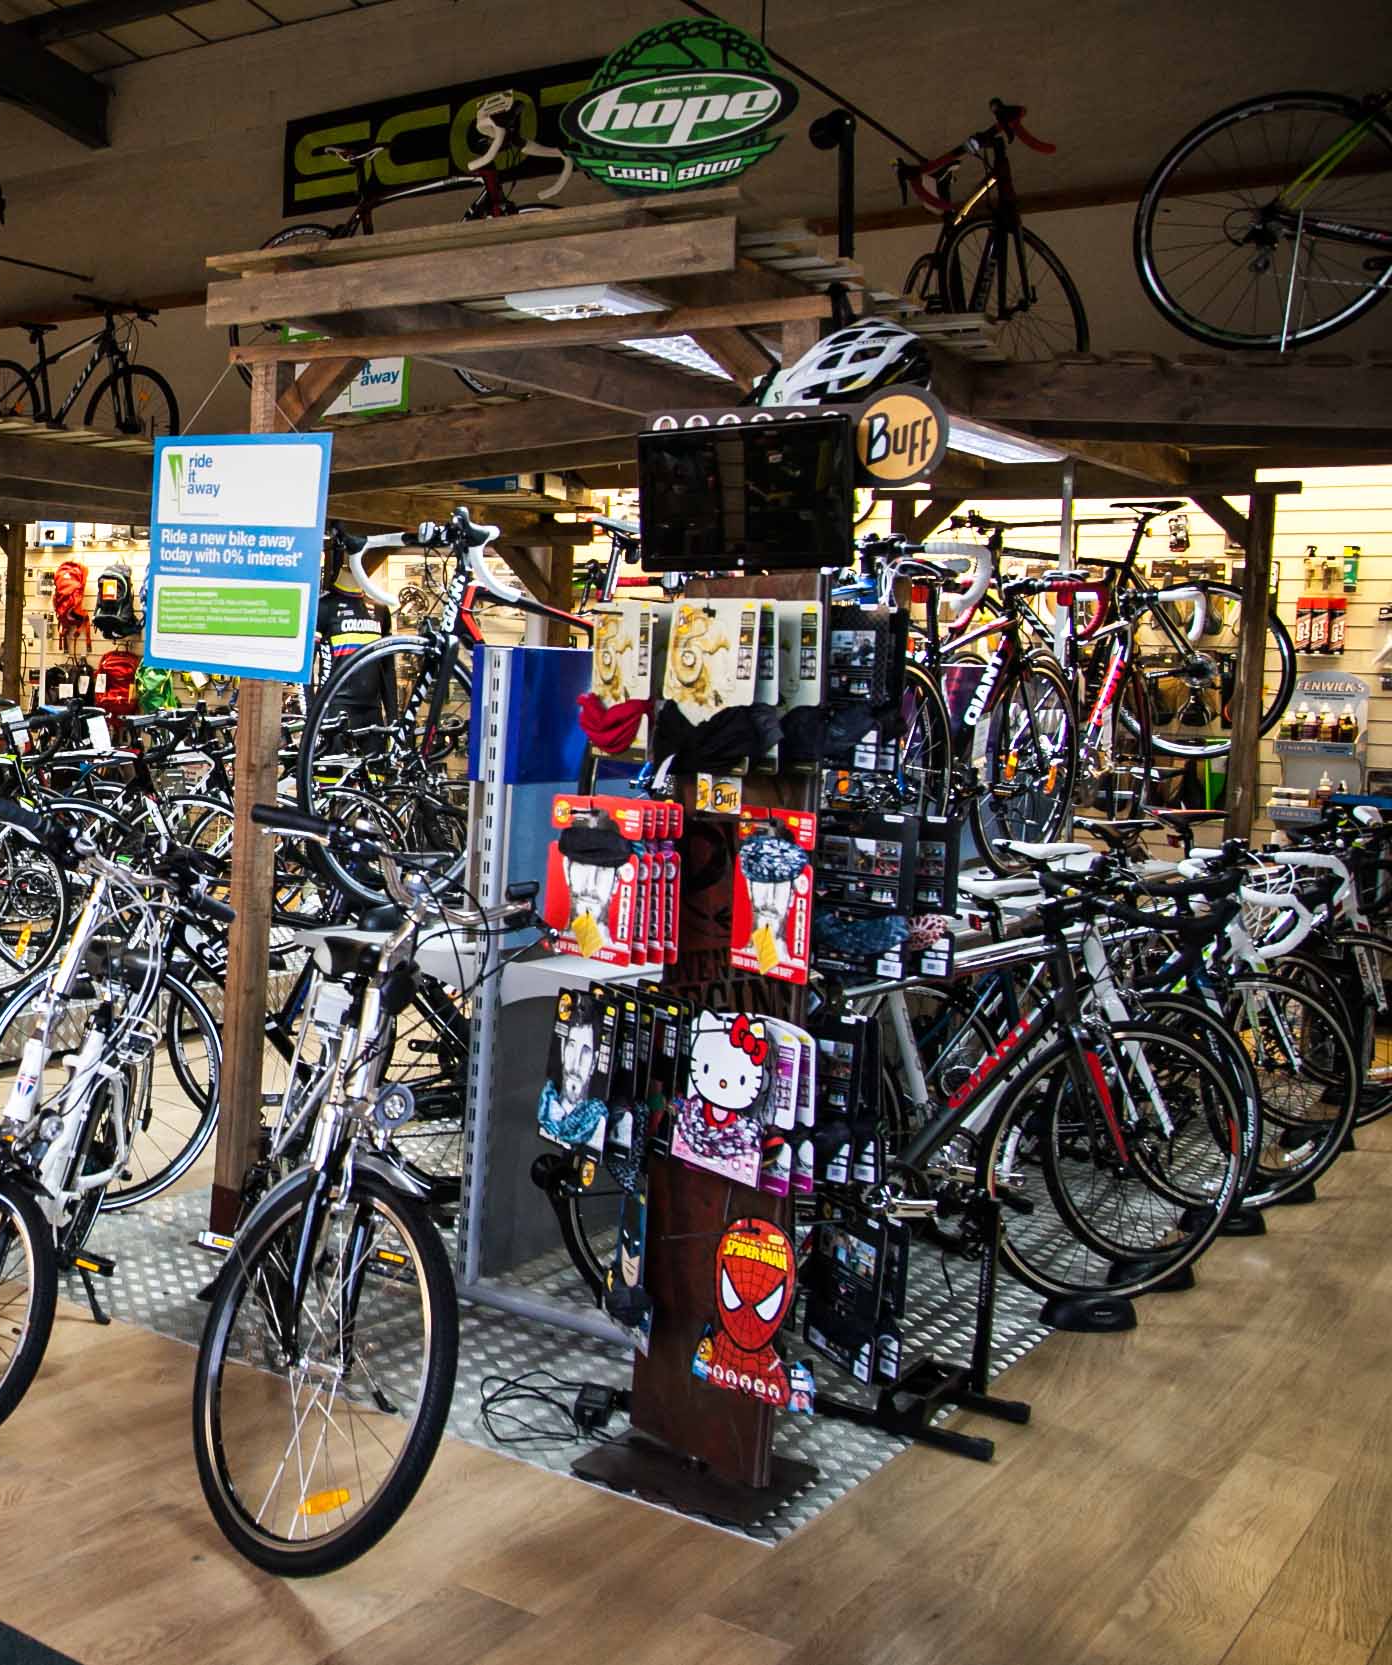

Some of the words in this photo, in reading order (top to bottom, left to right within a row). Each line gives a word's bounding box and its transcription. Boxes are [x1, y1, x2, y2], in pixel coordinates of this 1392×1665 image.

[587, 86, 777, 144] hope
[606, 165, 669, 182] tech
[677, 157, 743, 182] shop
[360, 370, 400, 386] away
[189, 453, 213, 468] ride
[188, 469, 196, 483] it
[187, 483, 221, 498] away
[160, 528, 188, 544] Ride
[189, 532, 198, 545] a
[200, 533, 226, 546] new
[228, 530, 257, 547] bike
[258, 535, 295, 551] away
[159, 547, 193, 566] today
[195, 547, 221, 563] with
[223, 549, 245, 565] 0%
[963, 651, 1003, 726] GIANT
[946, 1018, 1031, 1110] GIANT
[722, 1238, 788, 1273] SPIDER-MAN
